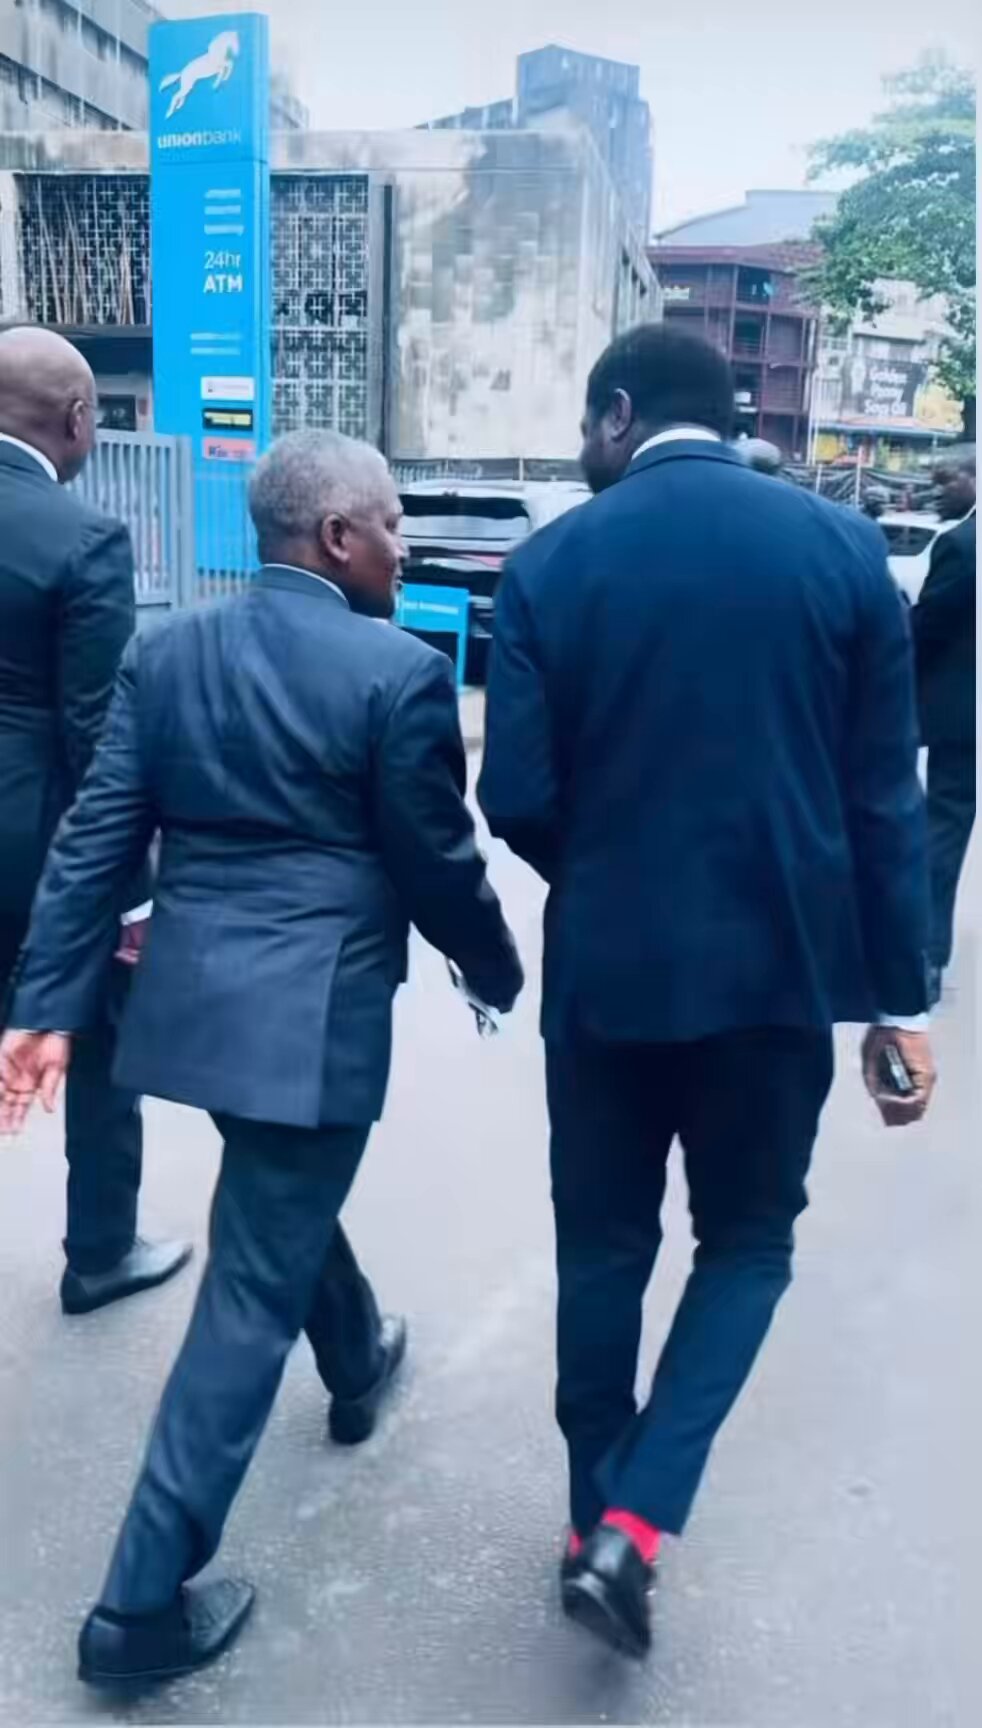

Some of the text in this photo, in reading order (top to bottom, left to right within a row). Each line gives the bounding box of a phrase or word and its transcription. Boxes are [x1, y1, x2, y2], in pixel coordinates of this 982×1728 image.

[157, 128, 241, 149] unionbank
[204, 250, 241, 270] 24hr
[203, 273, 243, 294] ATM
